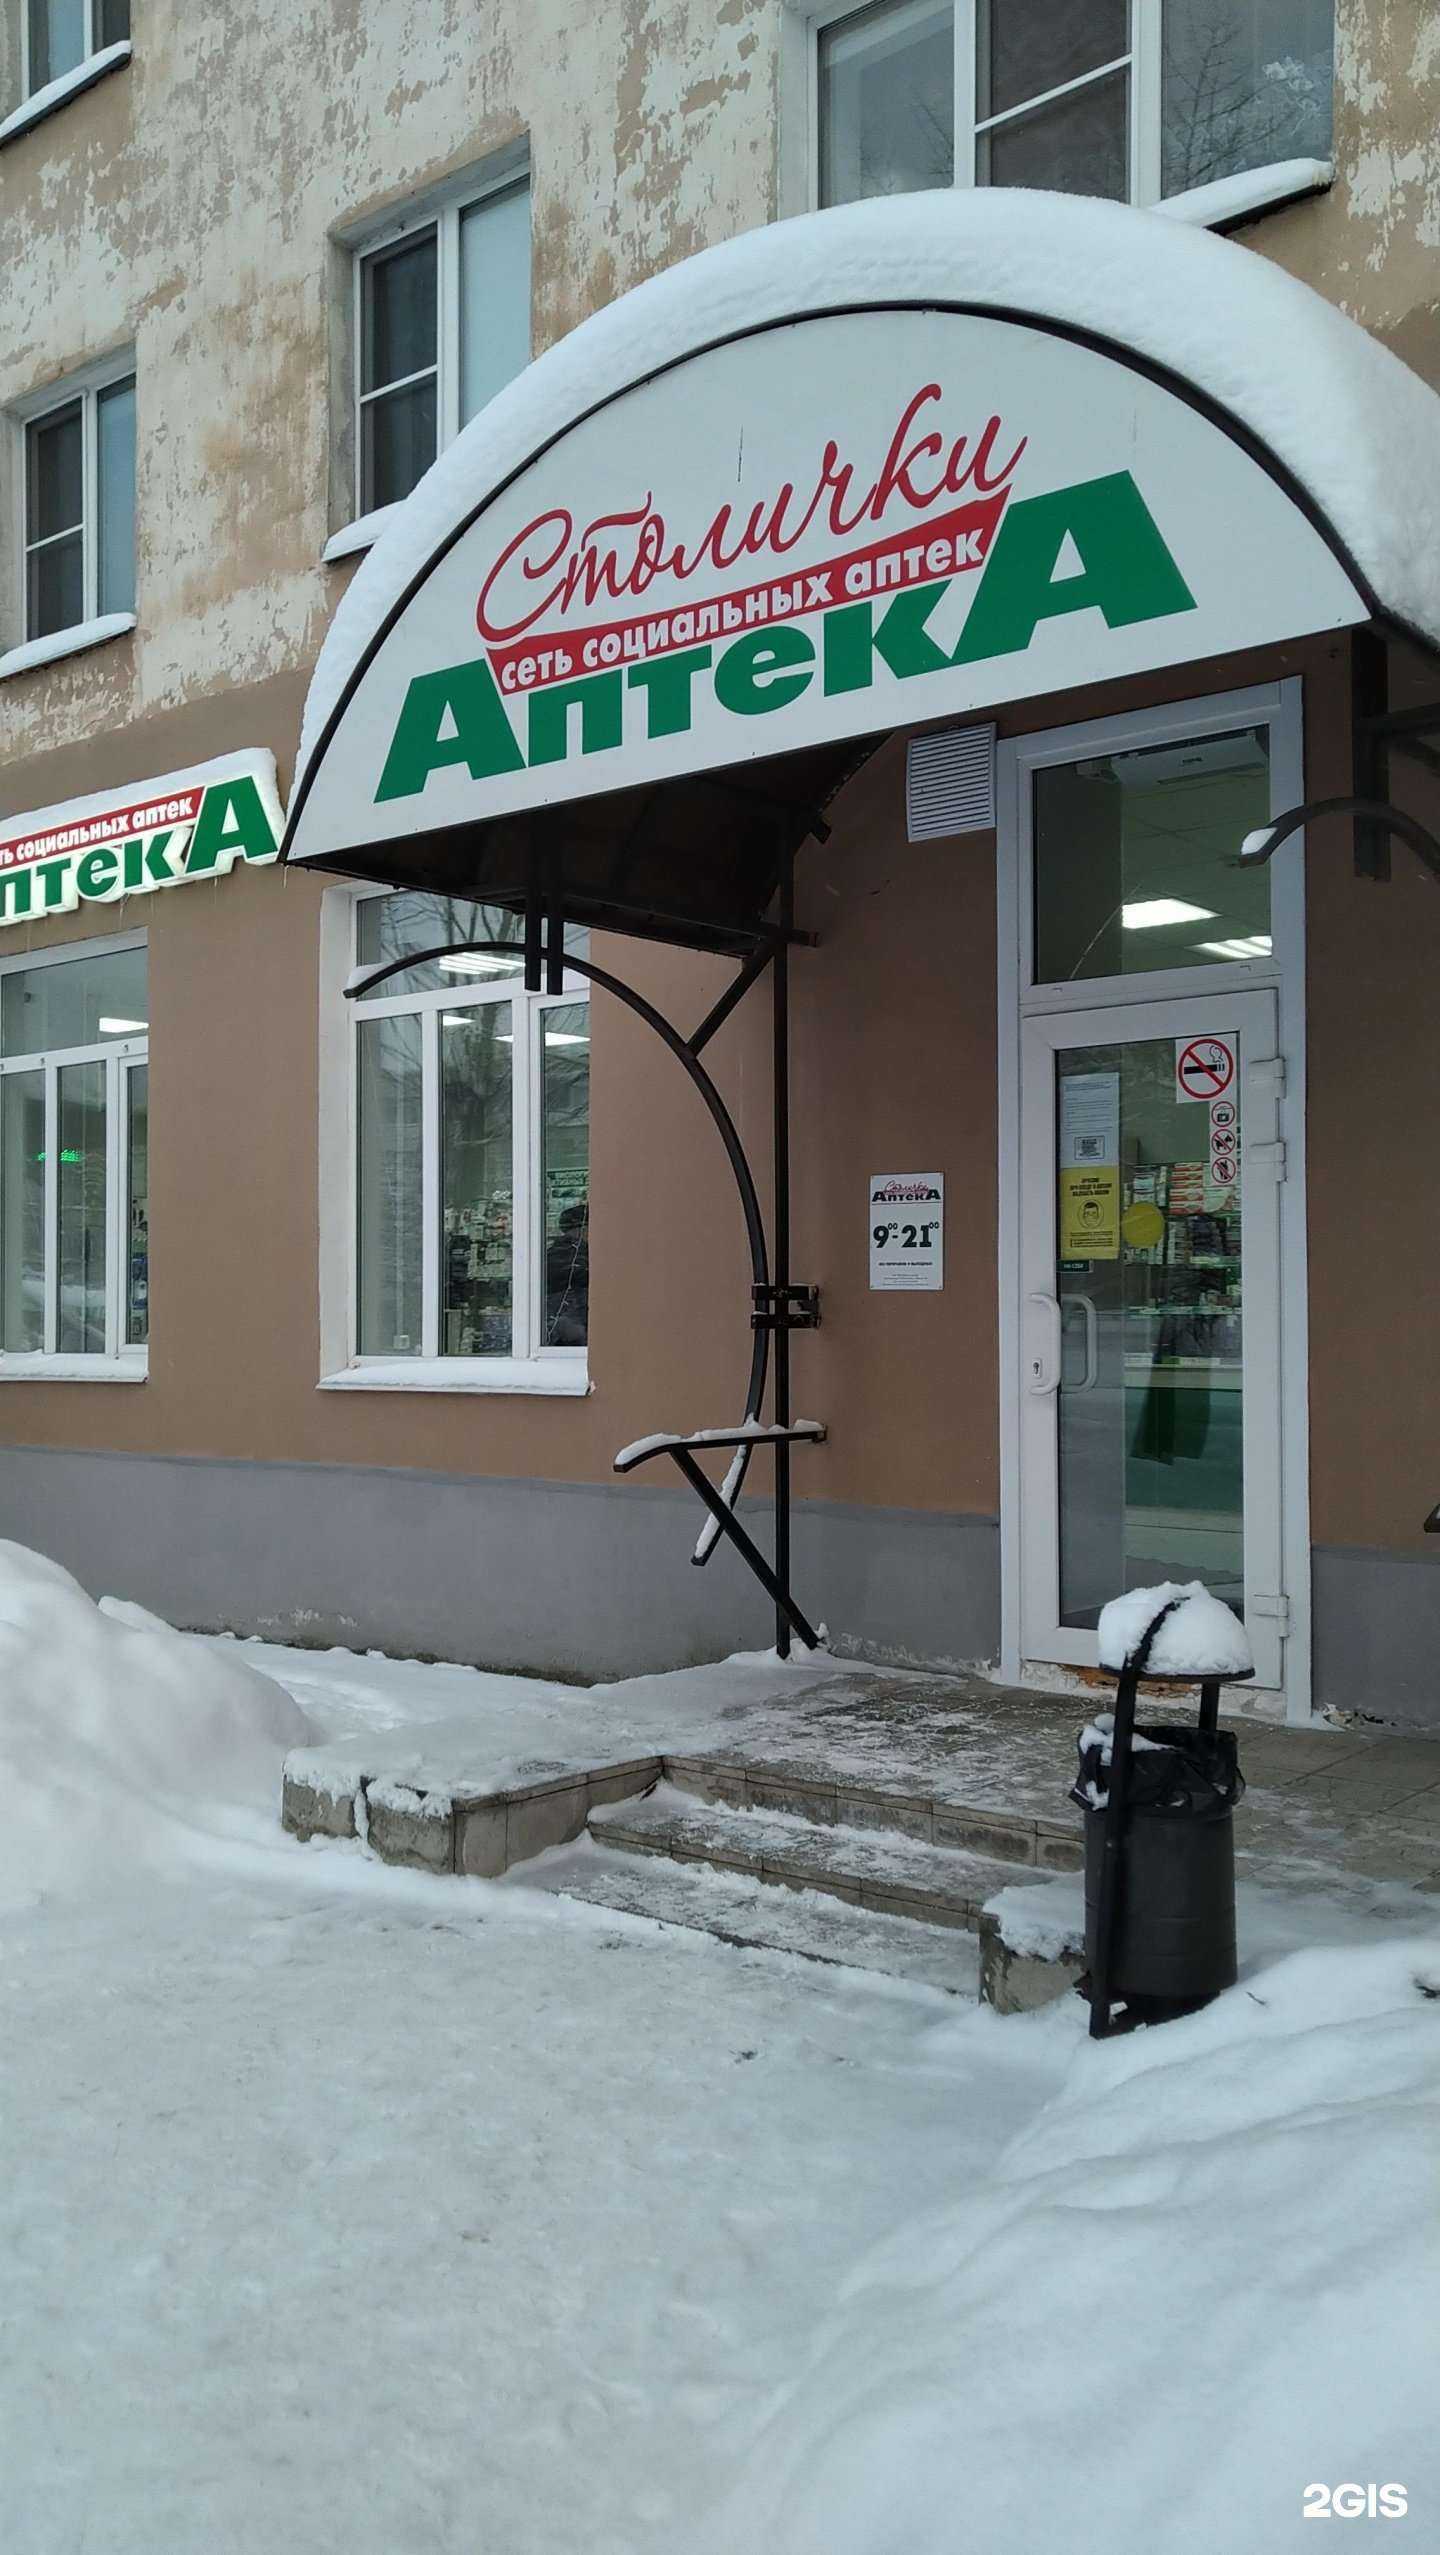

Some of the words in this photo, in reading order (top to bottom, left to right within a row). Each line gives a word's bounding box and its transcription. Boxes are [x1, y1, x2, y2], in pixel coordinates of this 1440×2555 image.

[477, 383, 1027, 643] Столички
[501, 648, 573, 690] сеть
[582, 571, 833, 668] социальных
[844, 528, 984, 596] аптек
[16, 814, 130, 861] социальных
[132, 796, 193, 827] аптек
